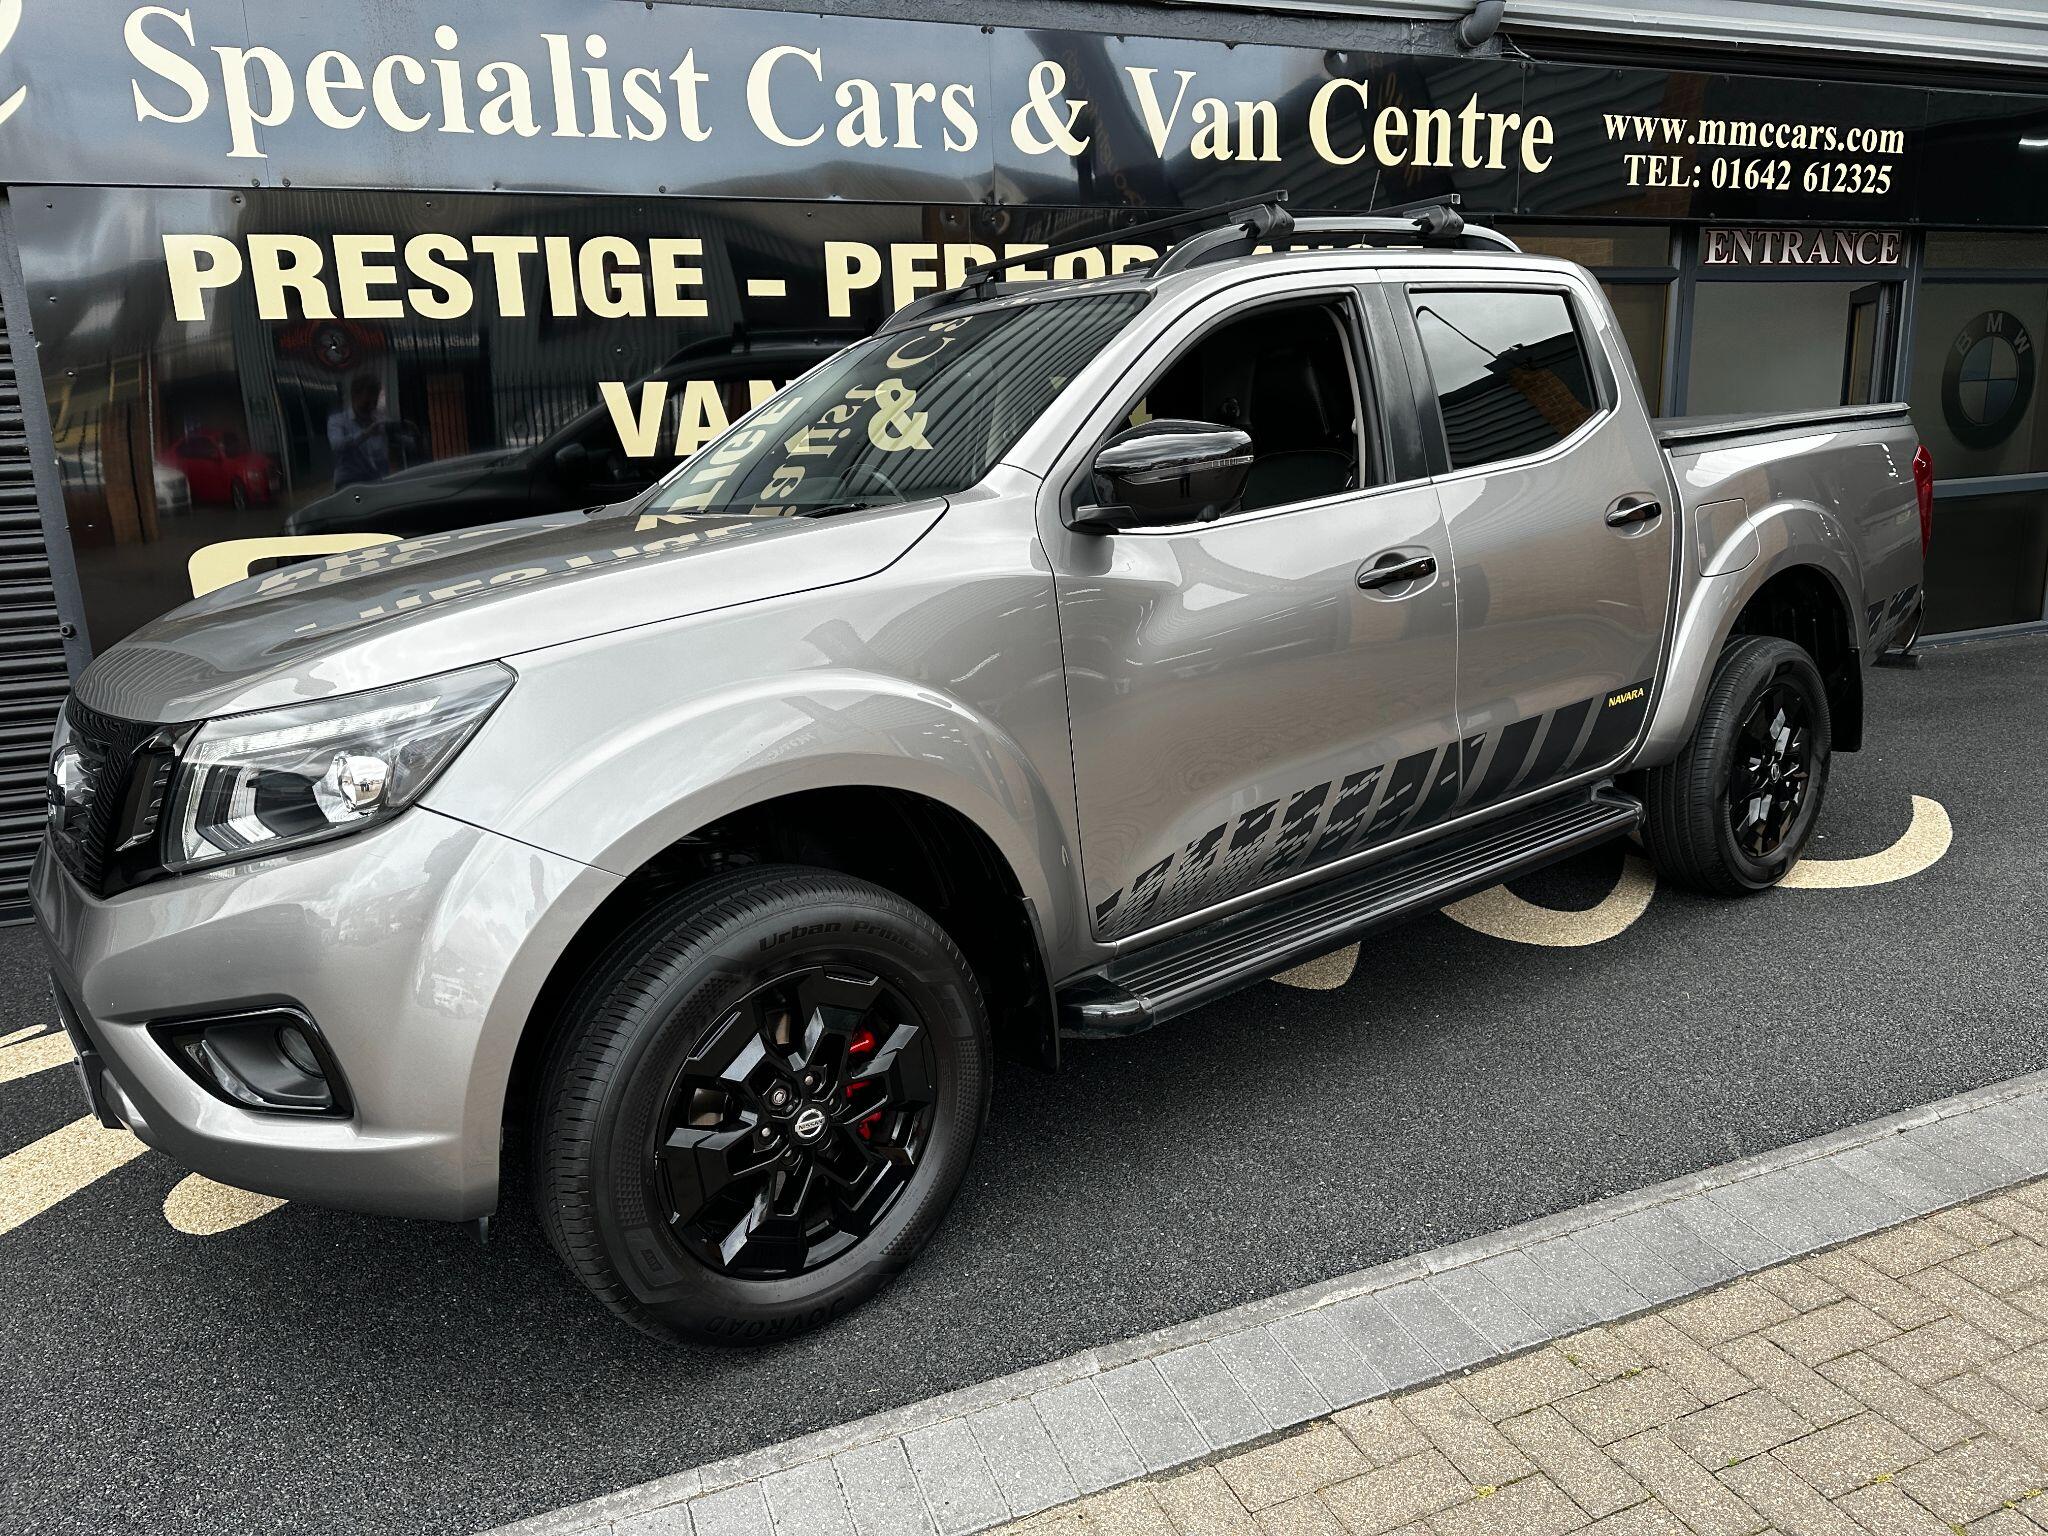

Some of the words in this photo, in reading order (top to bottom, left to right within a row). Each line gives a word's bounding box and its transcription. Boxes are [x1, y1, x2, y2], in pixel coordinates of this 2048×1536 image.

[124, 6, 713, 158] Specialist
[747, 46, 979, 153] Cars
[1010, 60, 1091, 157] &
[1125, 67, 1282, 162] Van
[1308, 78, 1554, 174] Centre
[1602, 114, 1904, 154] www.mmccars.com
[1624, 154, 1701, 188] TEL:
[1711, 157, 1791, 190] 01642
[1803, 161, 1893, 194] 612325
[1704, 229, 1901, 266] ENTRANCE
[162, 233, 709, 322] PRESTIGE
[1955, 313, 2030, 356] BMW
[1608, 687, 1645, 708] NAVARA
